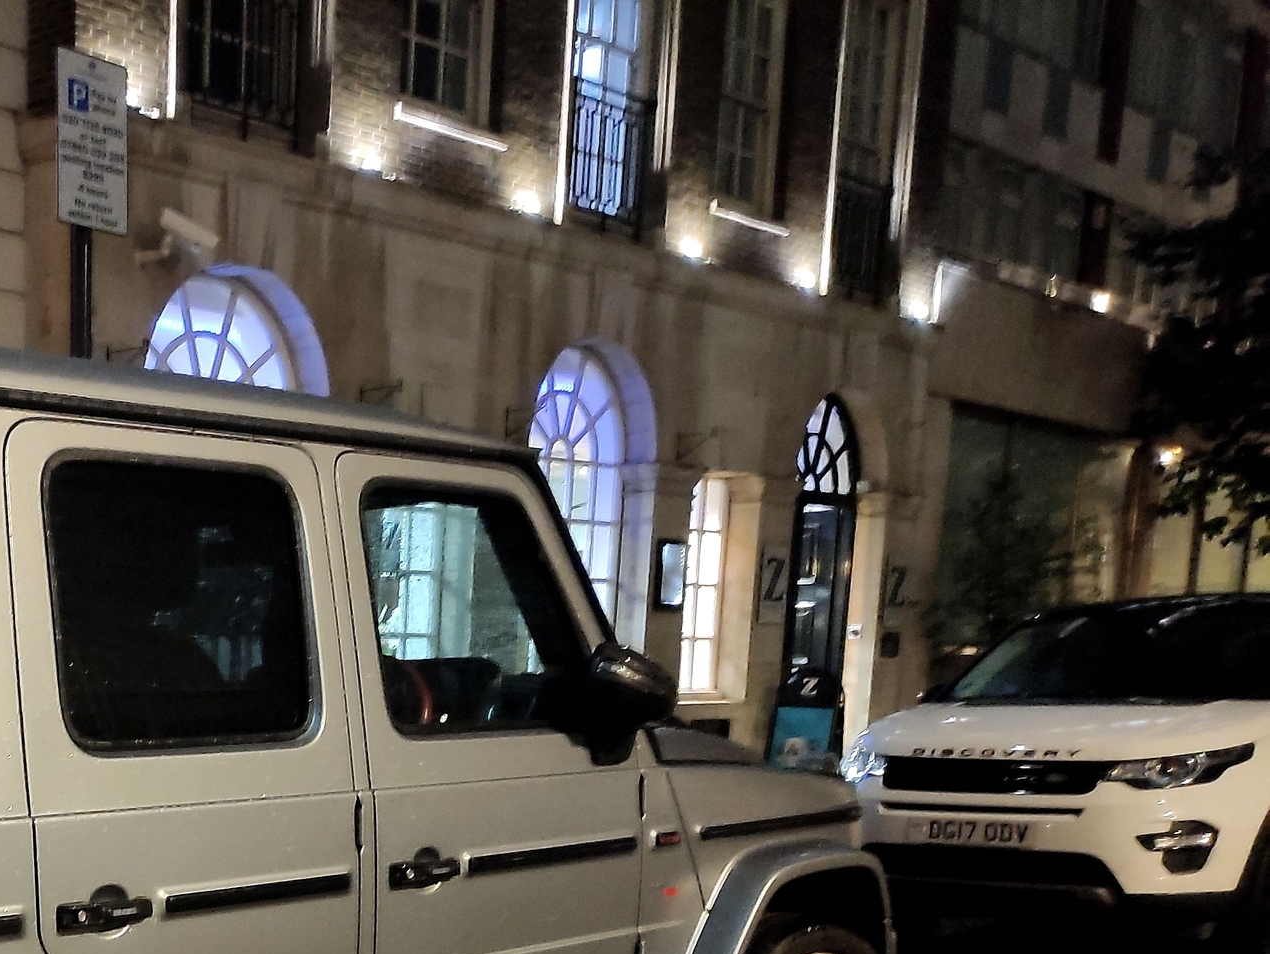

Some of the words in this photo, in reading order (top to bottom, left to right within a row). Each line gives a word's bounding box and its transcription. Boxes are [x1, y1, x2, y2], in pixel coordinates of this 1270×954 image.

[764, 557, 786, 601] Z
[887, 566, 908, 606] Z
[800, 677, 821, 697] Z
[912, 747, 1082, 758] DISCOVERY
[929, 820, 977, 841] DG17
